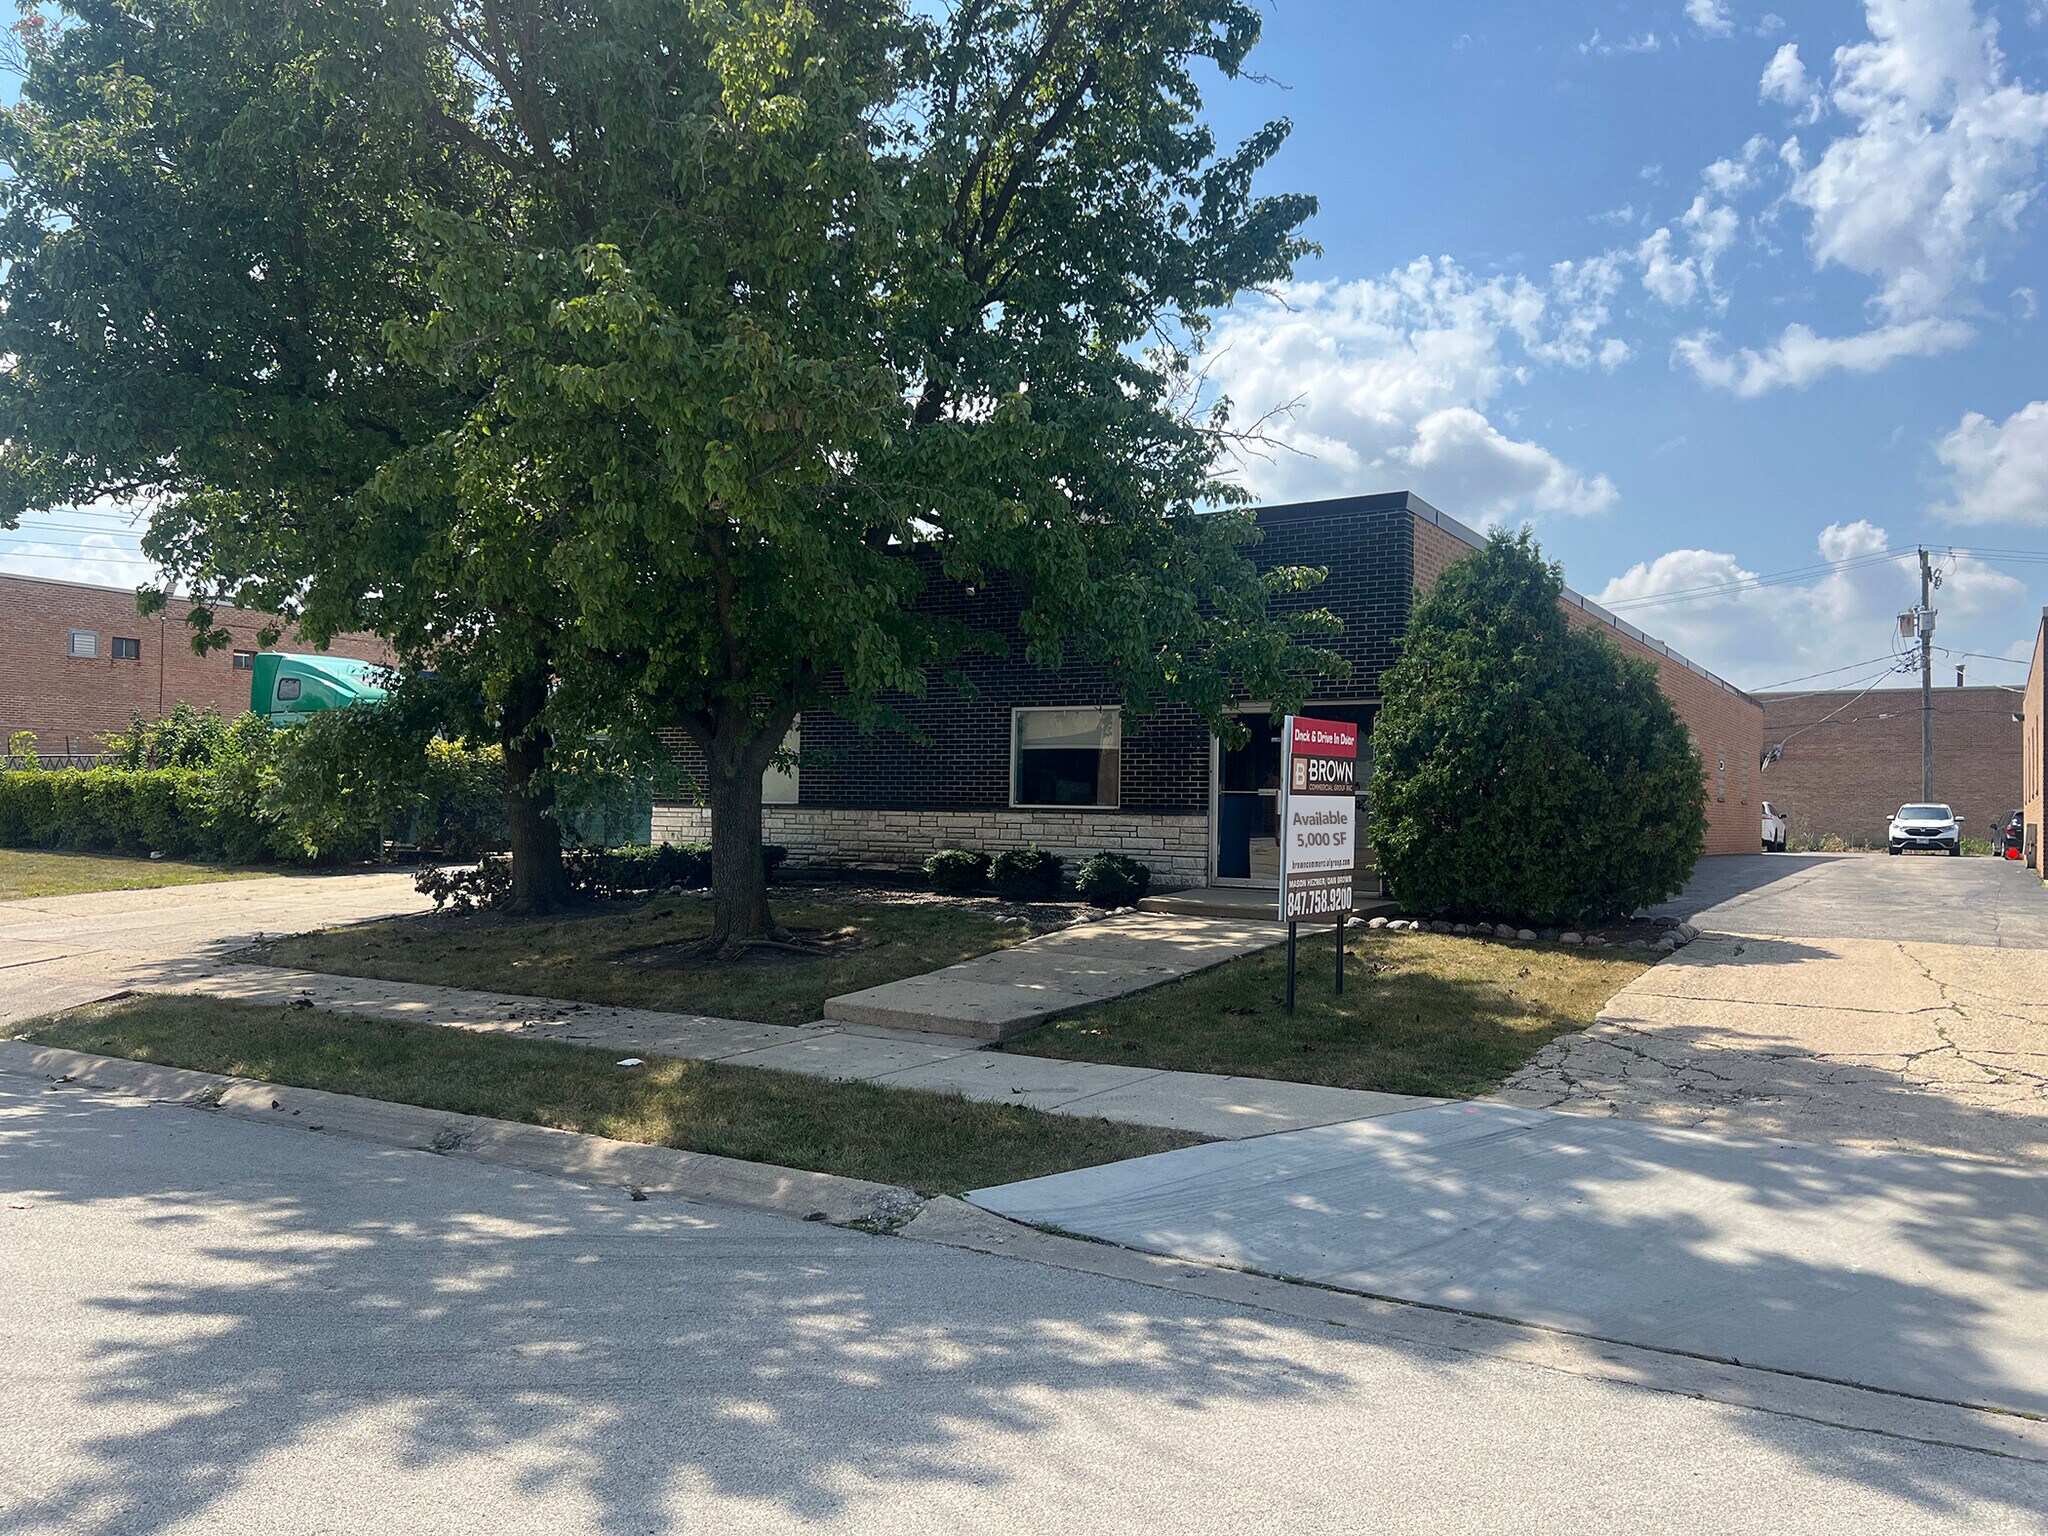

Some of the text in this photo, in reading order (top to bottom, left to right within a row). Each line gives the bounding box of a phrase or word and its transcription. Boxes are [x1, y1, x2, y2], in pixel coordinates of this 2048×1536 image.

[1295, 729, 1354, 745] Dock & Drive In Door
[1308, 759, 1354, 782] BROWN
[1333, 784, 1346, 792] GROUP
[1292, 810, 1348, 826] Available
[1297, 831, 1347, 848] 5,000 SF
[1288, 879, 1307, 889] MASON
[1327, 876, 1336, 885] DAN
[1287, 886, 1352, 917] 847.758.9200
